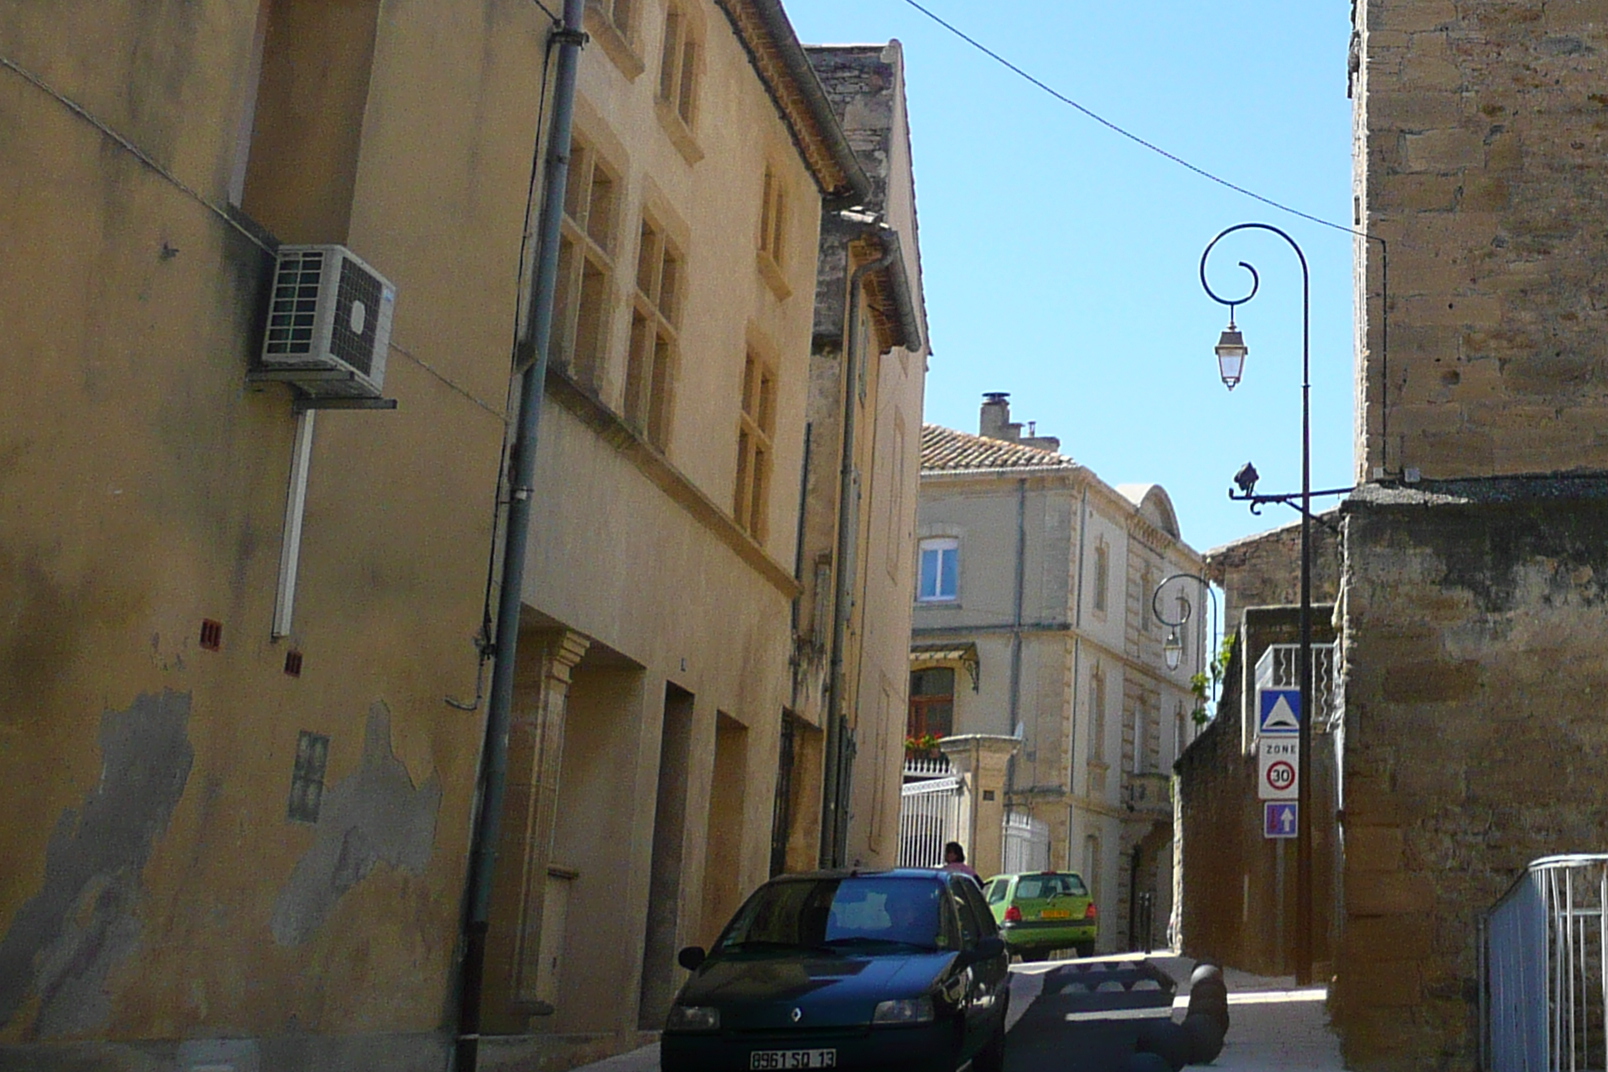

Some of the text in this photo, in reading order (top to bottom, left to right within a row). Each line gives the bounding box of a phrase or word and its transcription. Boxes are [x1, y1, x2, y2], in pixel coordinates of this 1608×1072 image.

[1266, 744, 1297, 755] ZONE
[1272, 769, 1290, 783] 30
[752, 1052, 787, 1069] 8961
[818, 1050, 835, 1067] 13
